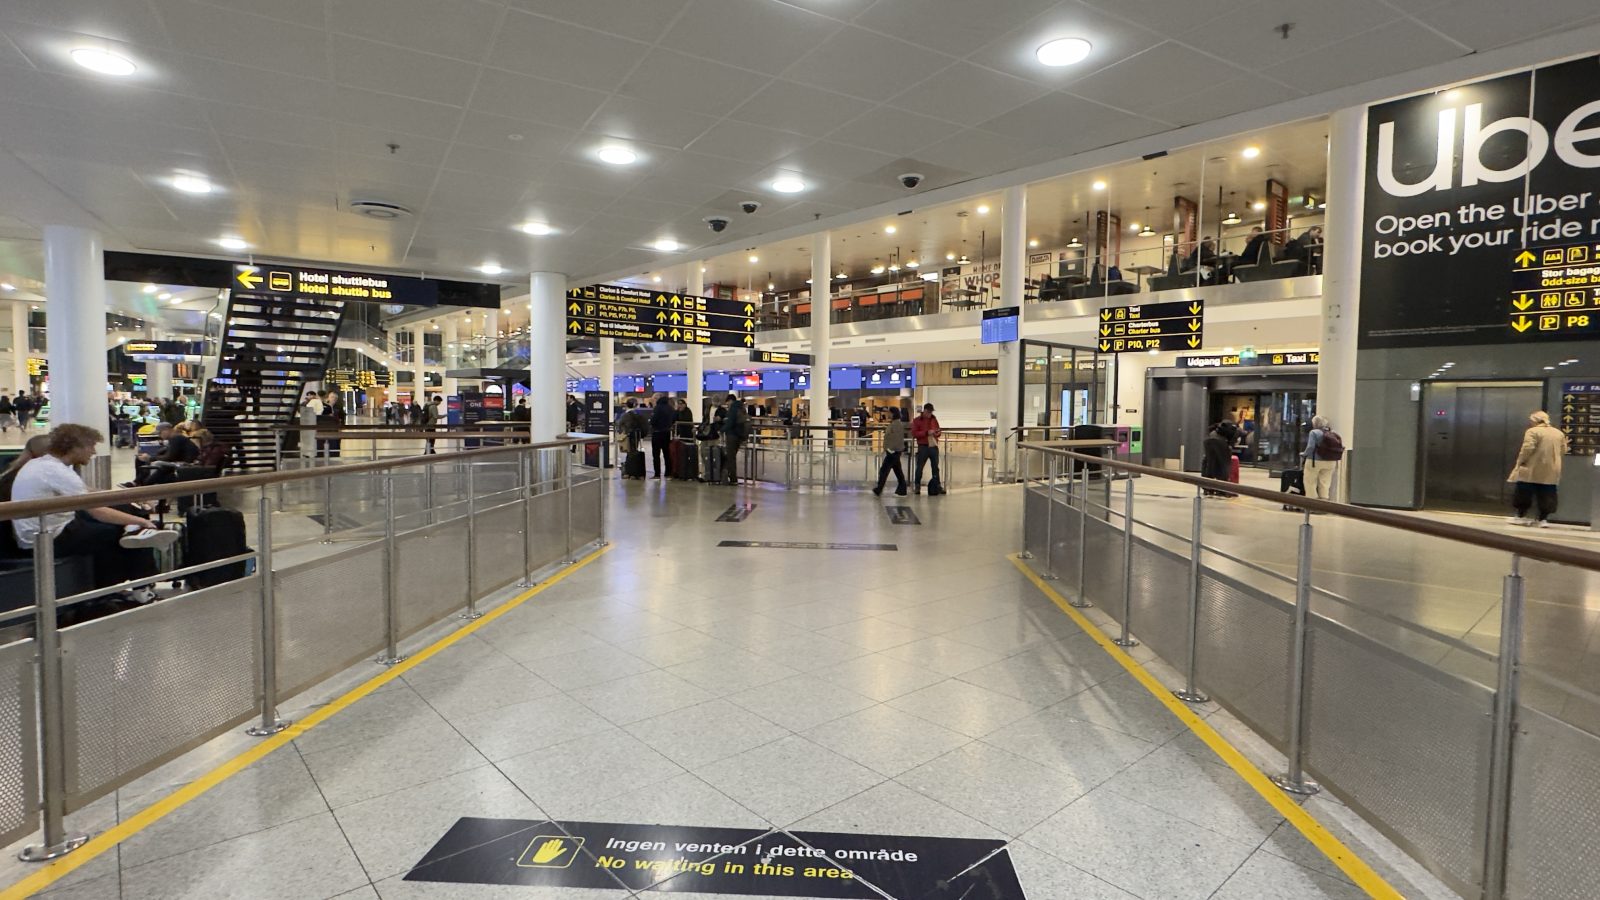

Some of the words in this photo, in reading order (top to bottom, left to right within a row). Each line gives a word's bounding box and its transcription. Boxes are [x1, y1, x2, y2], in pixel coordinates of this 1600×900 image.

[1375, 212, 1450, 237] Open
[1458, 204, 1504, 224] the
[1514, 192, 1592, 216] Uber
[1374, 237, 1443, 258] book
[1449, 229, 1513, 255] your
[1522, 219, 1582, 243] ride
[299, 272, 328, 283] Hotel
[332, 275, 387, 288] shuttlebus
[1542, 269, 1563, 278] Stor
[1542, 277, 1587, 286] Odd-size
[299, 283, 328, 294] Hotel
[332, 285, 369, 297] shuttle
[372, 288, 392, 299] bus
[1568, 316, 1589, 327] P8
[1128, 340, 1143, 349] P10,
[1146, 339, 1160, 348] P12
[1187, 357, 1221, 367] Udgang
[1222, 356, 1240, 365] Exit
[1286, 354, 1306, 363] Taxi
[606, 838, 665, 853] Ingen
[675, 841, 746, 855] venten
[755, 844, 762, 855] i
[770, 844, 826, 858] dette
[835, 848, 918, 862] område
[596, 856, 626, 869] No
[635, 859, 714, 876] waiting
[724, 861, 744, 874] in
[753, 863, 794, 877] this
[804, 866, 854, 880] area
